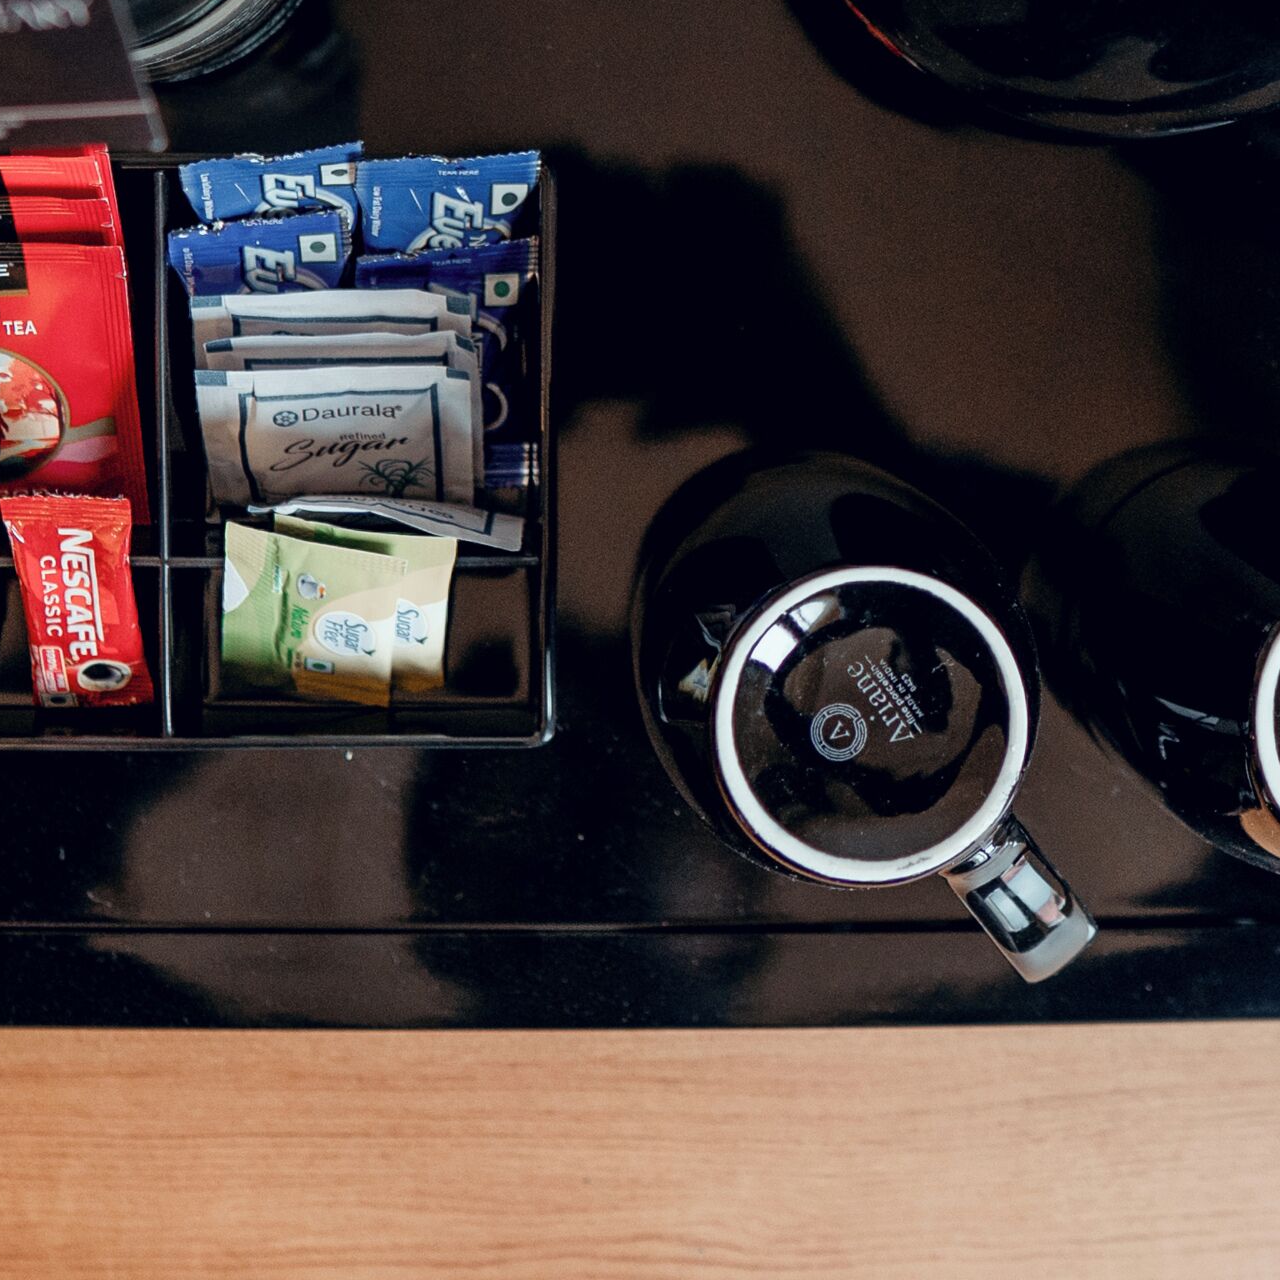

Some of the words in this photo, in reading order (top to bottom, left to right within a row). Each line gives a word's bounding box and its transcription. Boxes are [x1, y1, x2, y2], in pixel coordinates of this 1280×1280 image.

[2, 320, 38, 336] TEA
[301, 404, 397, 422] Daurala
[269, 436, 409, 471] Sugar
[39, 554, 63, 637] CLASSIC
[341, 619, 369, 653] Sugar
[395, 608, 420, 642] Sugar
[870, 664, 905, 706] porcelain
[879, 658, 898, 684] INDIA
[847, 661, 915, 742] Ariane
[896, 683, 907, 694] IN
[901, 706, 916, 725] fine
[904, 693, 925, 718] MADE
